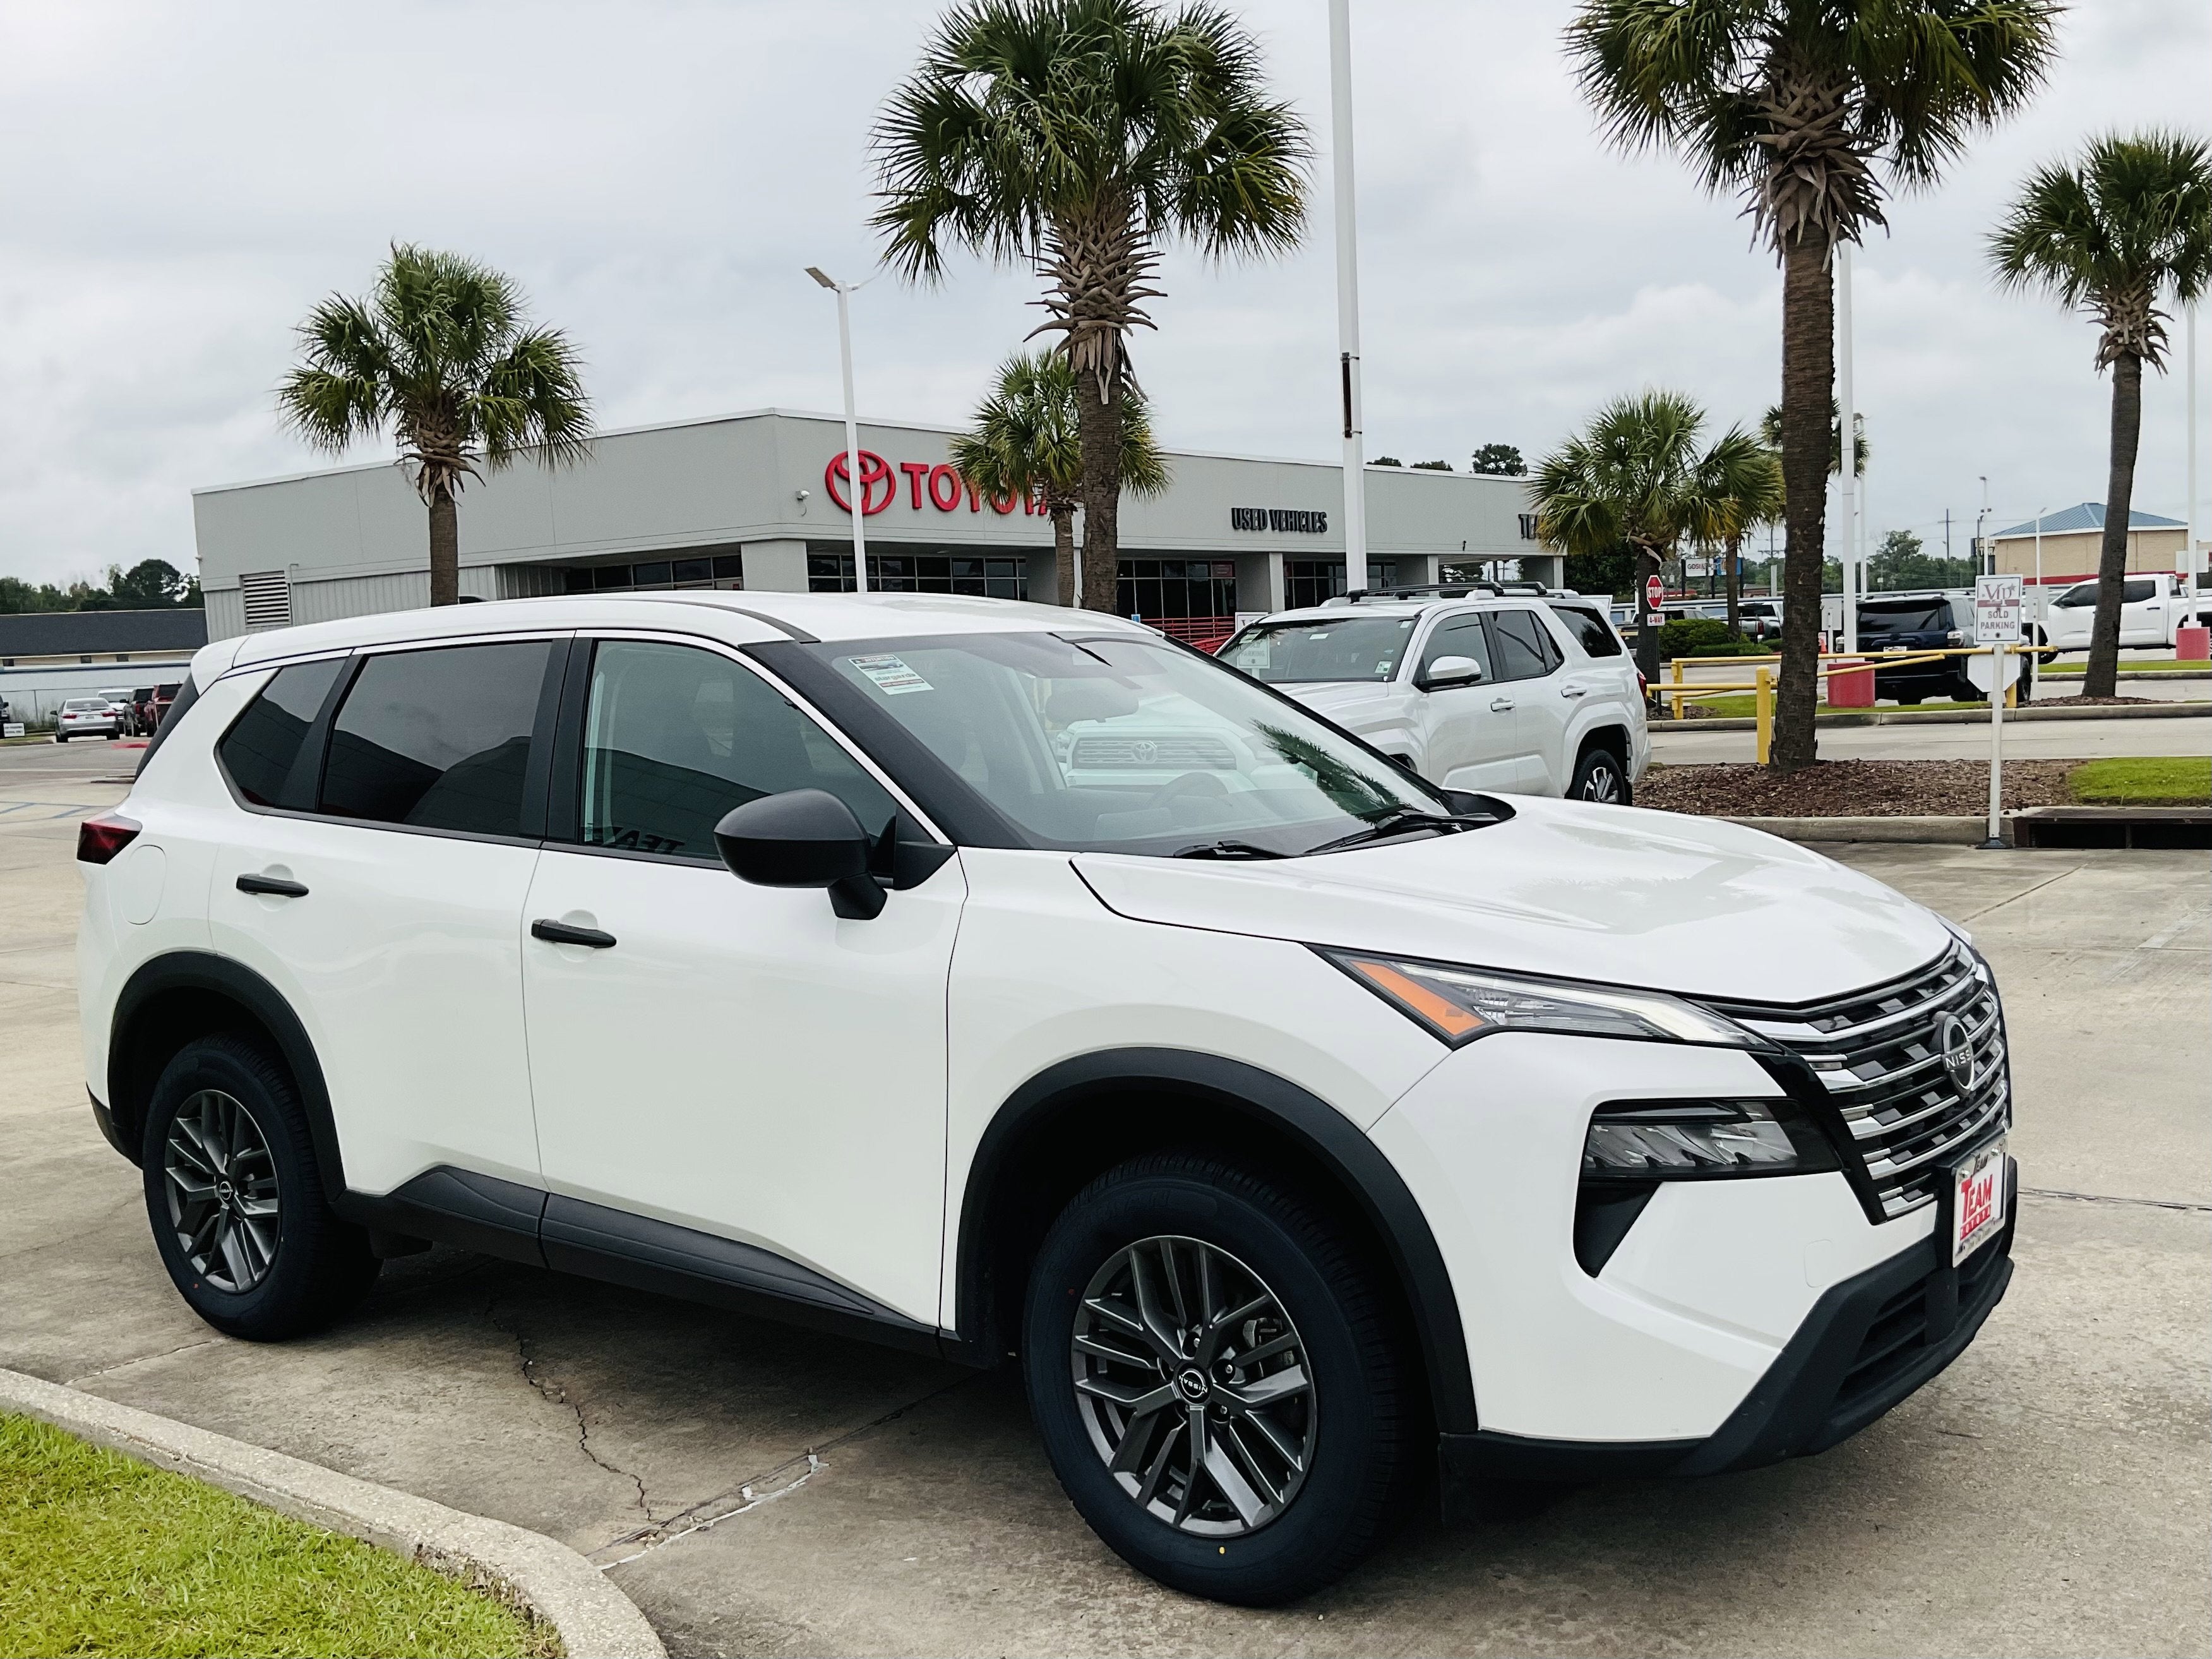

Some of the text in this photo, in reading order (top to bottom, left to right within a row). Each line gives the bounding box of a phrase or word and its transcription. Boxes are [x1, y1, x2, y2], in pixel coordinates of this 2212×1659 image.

[1231, 508, 1327, 532] USED VEHICLES
[1647, 587, 1661, 598] STOP
[1983, 584, 2012, 605] VIP
[1980, 621, 2015, 630] PARKING
[1945, 1049, 1971, 1069] NISS
[1961, 1173, 1993, 1224] TEAM
